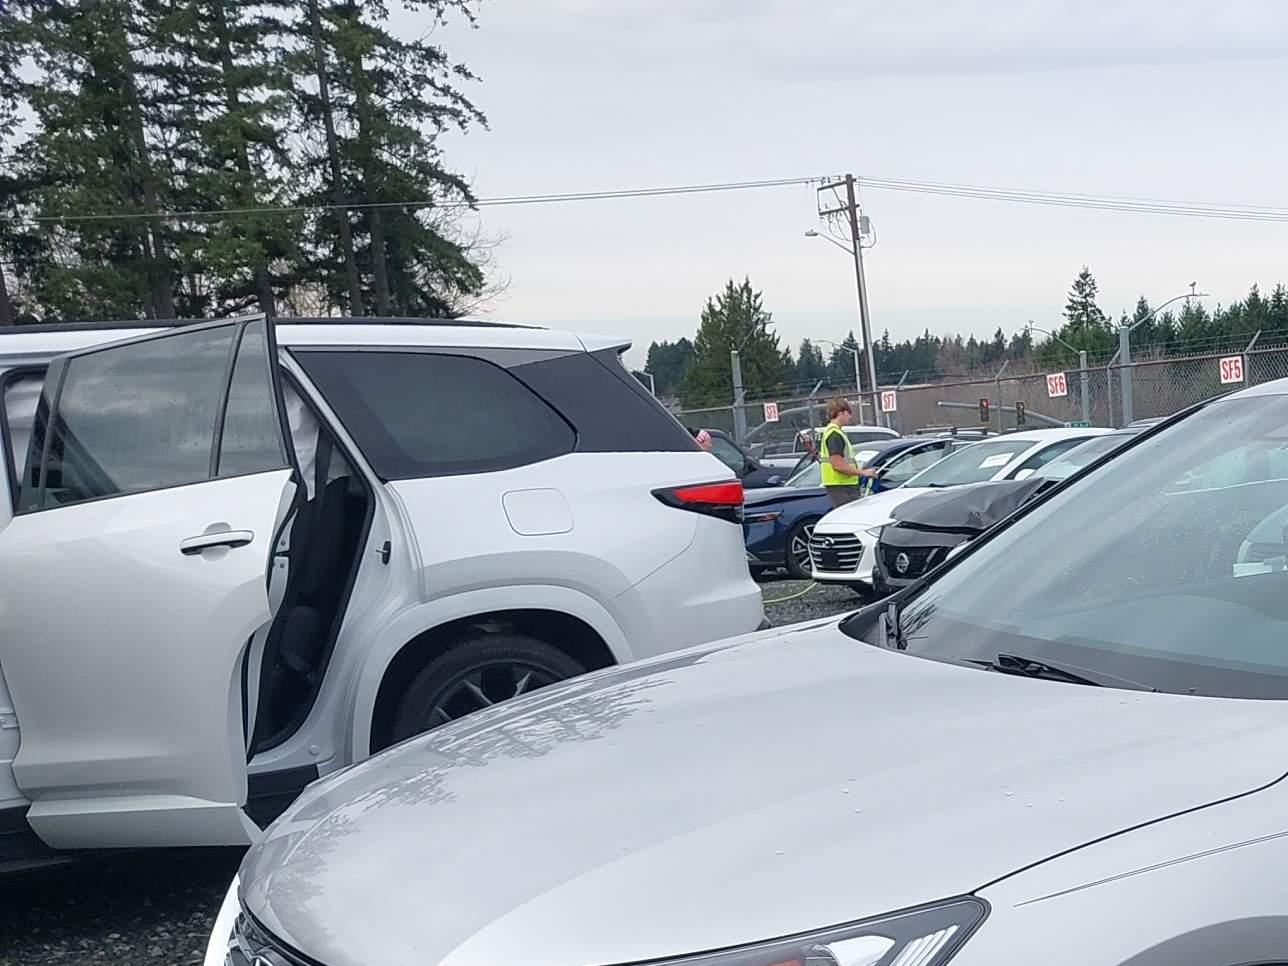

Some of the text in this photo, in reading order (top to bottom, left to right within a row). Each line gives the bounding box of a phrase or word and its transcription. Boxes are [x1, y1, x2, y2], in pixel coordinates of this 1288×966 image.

[1221, 359, 1241, 380] SF5
[1048, 375, 1065, 395] SF6
[883, 393, 894, 410] SF7
